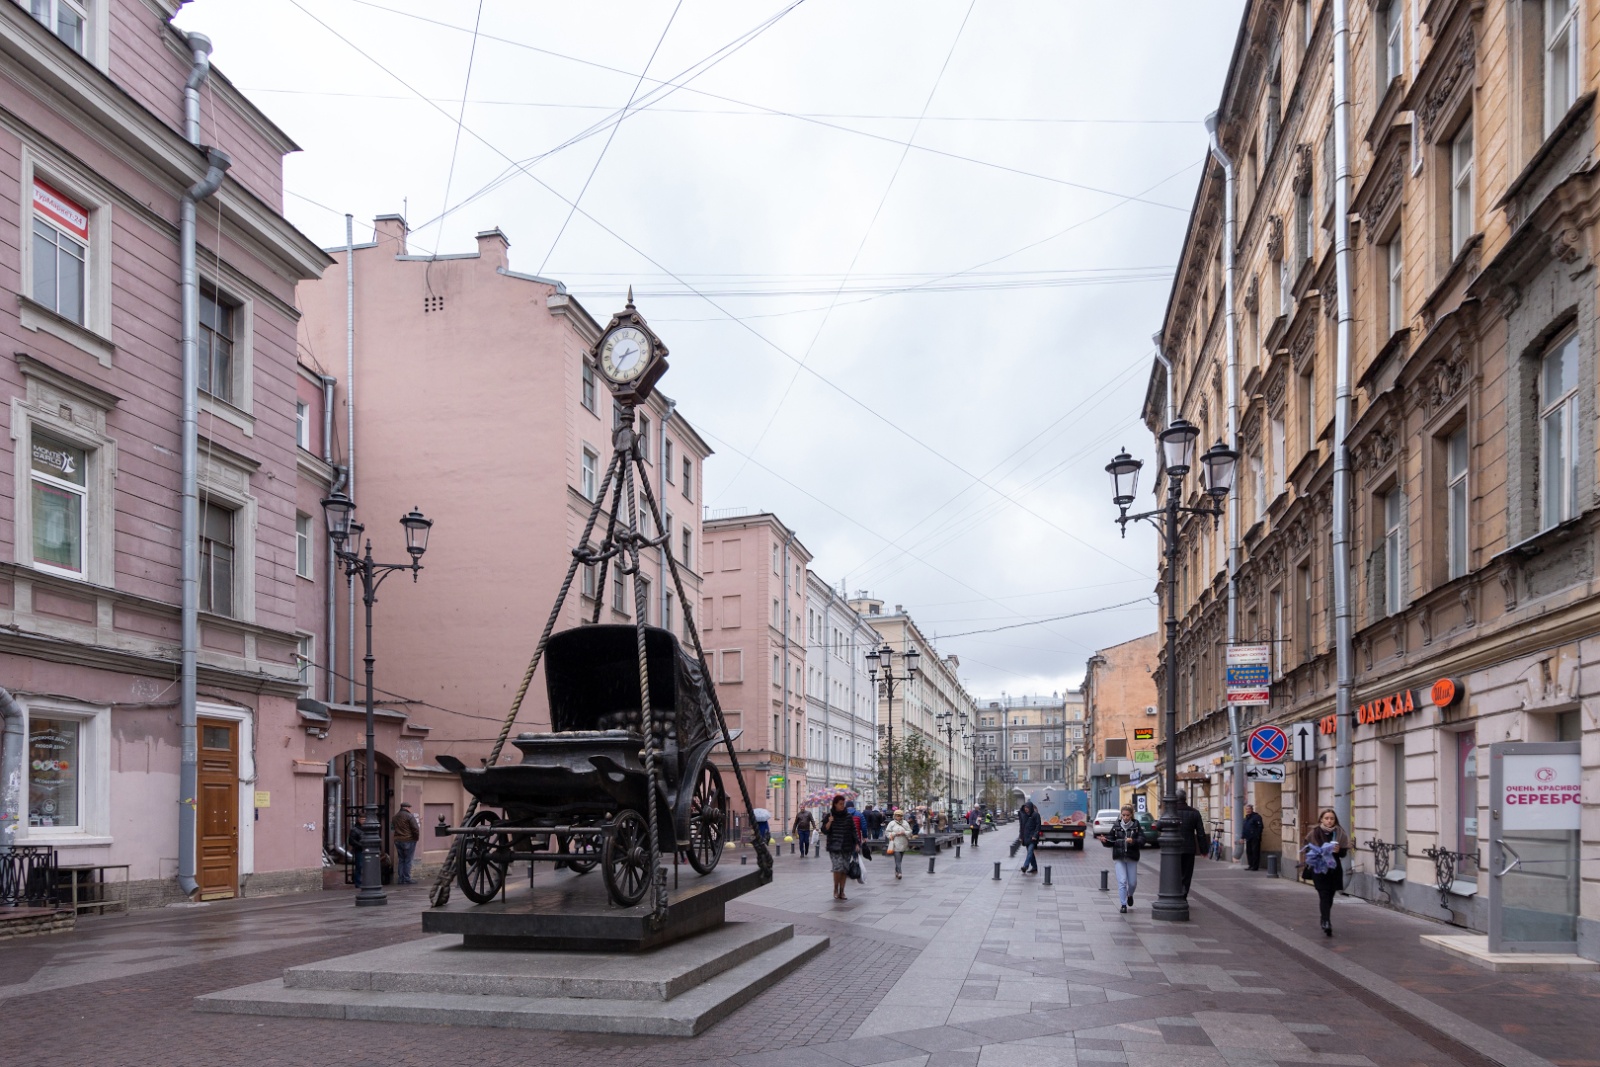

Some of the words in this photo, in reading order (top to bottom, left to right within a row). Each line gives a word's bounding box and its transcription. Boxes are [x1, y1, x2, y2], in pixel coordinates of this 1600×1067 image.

[33, 444, 61, 459] MONTE
[33, 451, 62, 466] CARLO
[1359, 689, 1414, 725] ОДЕЖДА
[1320, 714, 1337, 735] ОБУ
